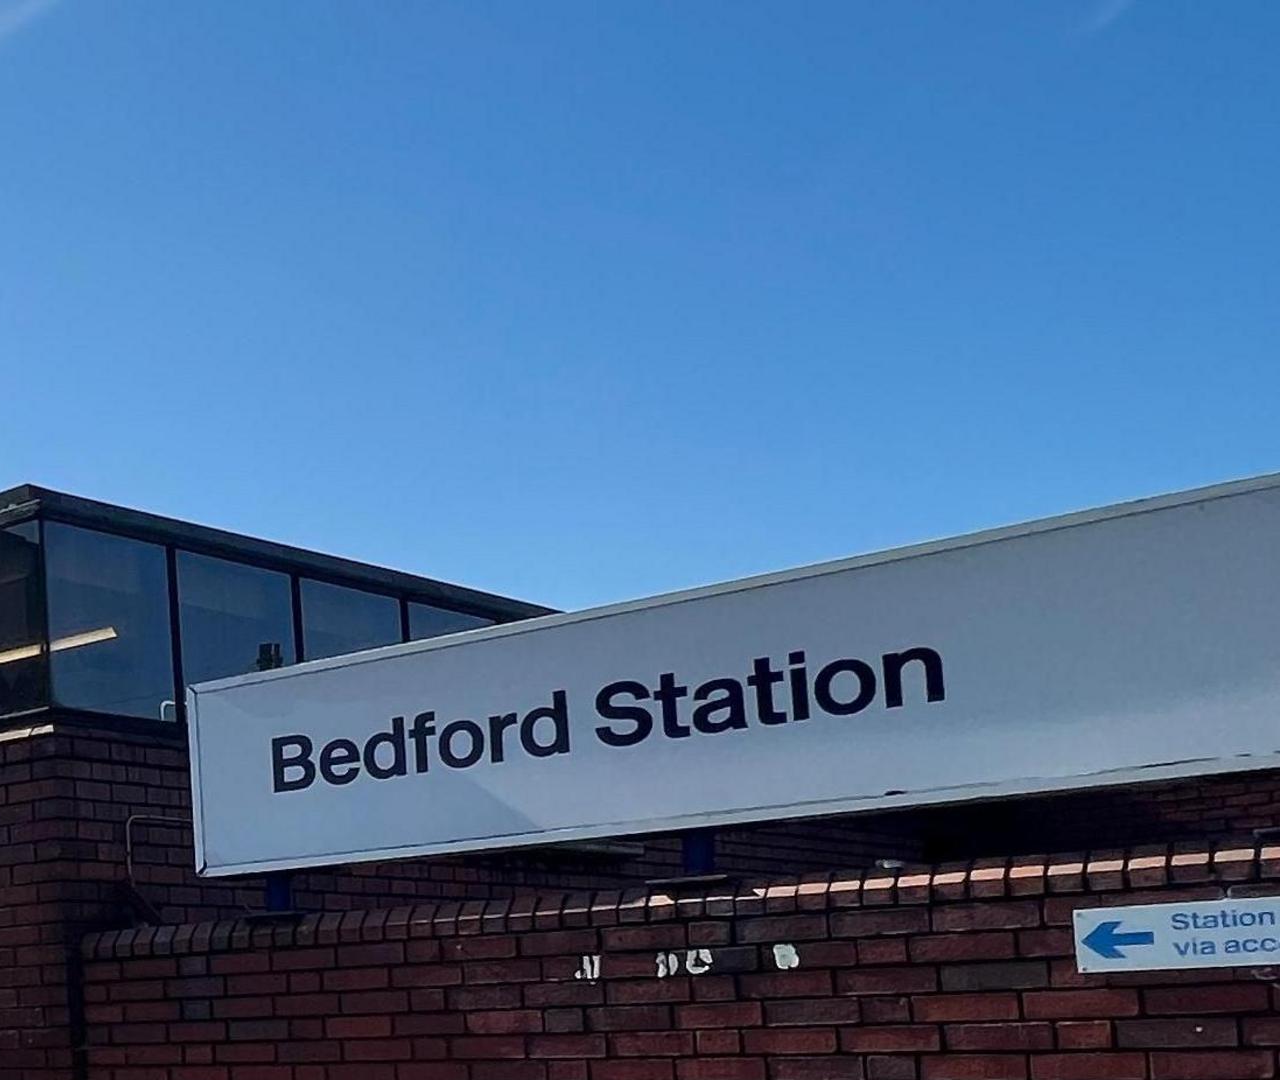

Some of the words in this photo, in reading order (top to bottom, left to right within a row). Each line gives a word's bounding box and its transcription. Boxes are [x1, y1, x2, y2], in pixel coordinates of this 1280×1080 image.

[272, 688, 571, 794] Bedford
[593, 645, 946, 748] Station
[1171, 909, 1276, 930] Station
[1172, 938, 1216, 956] via
[1224, 938, 1280, 954] acc
